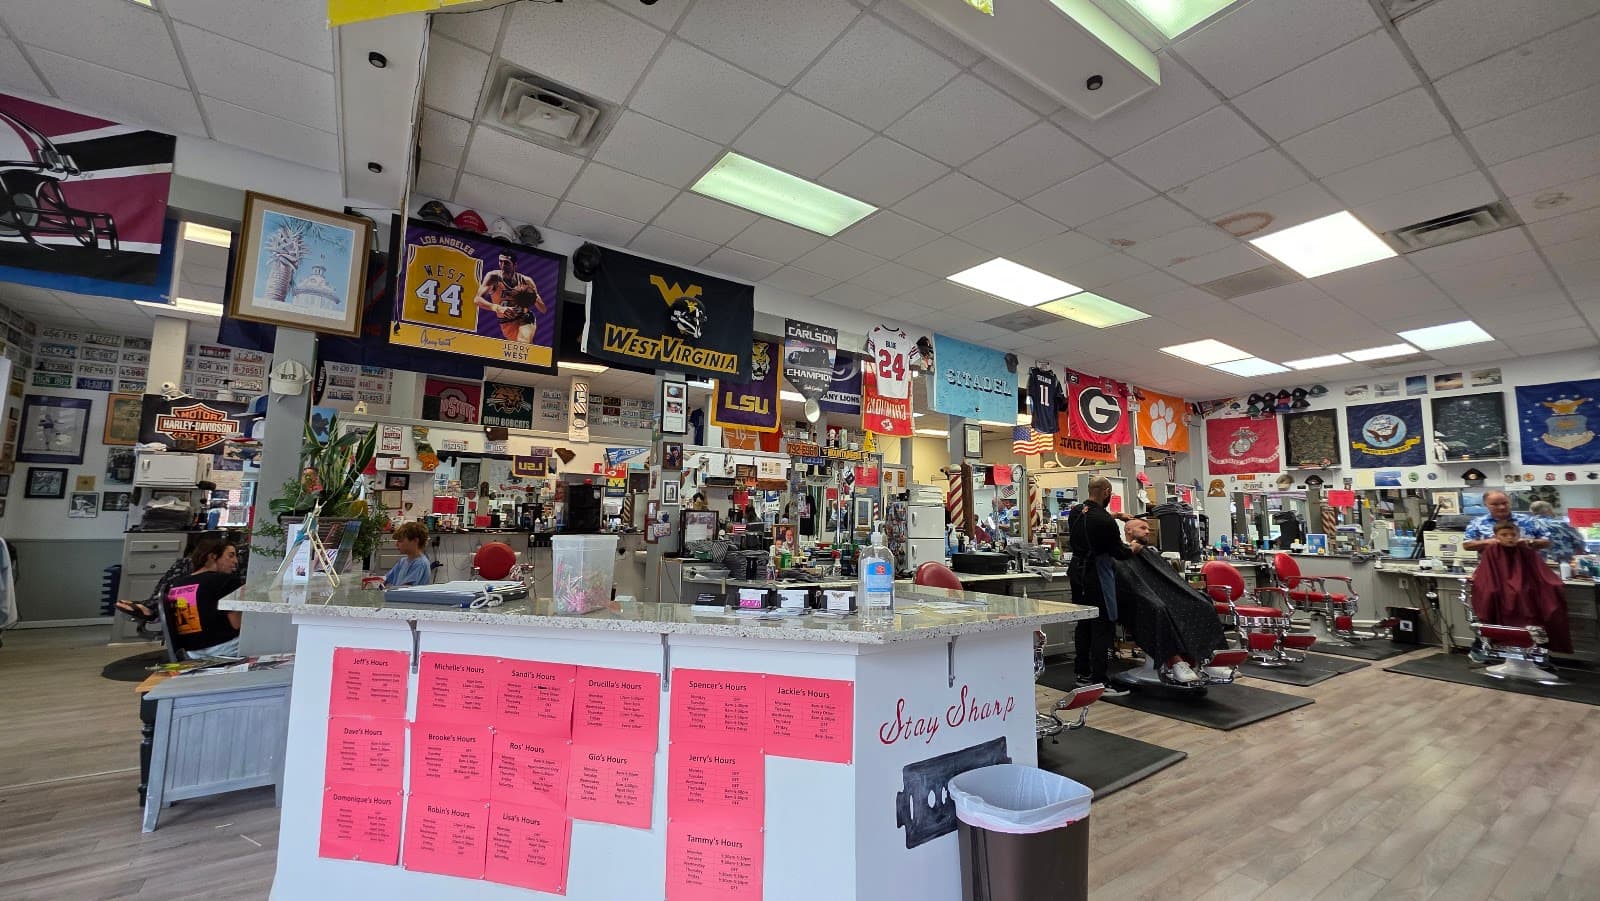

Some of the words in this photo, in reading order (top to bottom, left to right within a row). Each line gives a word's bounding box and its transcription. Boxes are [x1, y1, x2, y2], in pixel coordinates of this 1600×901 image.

[420, 235, 437, 245] LOS
[439, 237, 476, 256] ANGELES
[424, 265, 466, 282] WEST
[415, 279, 464, 318] 44
[788, 326, 836, 345] CARLSON
[503, 343, 530, 353] JERRY
[603, 322, 660, 359] WEST
[660, 335, 738, 373] VIRGINIA
[885, 340, 897, 349] BLUE
[503, 351, 528, 361] WEST
[878, 348, 905, 381] 24
[1039, 384, 1050, 406] 11
[725, 391, 769, 415] LSU
[181, 410, 218, 420] MOTOR
[1078, 386, 1122, 434] G
[163, 419, 232, 433] HARLEY-DAVIDSON
[484, 416, 499, 425] OHIO
[501, 418, 529, 428] BOBCATS
[435, 663, 464, 672] Michelle's
[511, 670, 534, 679] Sandi's
[588, 680, 619, 688] Drucilla's
[621, 682, 642, 690] Hours
[689, 681, 723, 690] Spencer's
[725, 683, 747, 691] Hours
[778, 687, 805, 696] Jackie's
[807, 690, 830, 698] Hours
[880, 698, 939, 744] Stay
[946, 685, 1016, 727] Sharp
[428, 733, 455, 741] Brooke's
[510, 742, 523, 750] Ros'
[525, 744, 544, 753] Hours
[588, 753, 605, 762] Gio's
[607, 755, 627, 764] Hours
[689, 754, 713, 763] Jerry's
[714, 756, 736, 764] Hours
[374, 797, 392, 805] Hours
[428, 806, 449, 815] Robin's
[451, 808, 470, 817] Hours
[502, 812, 519, 820] Lisa's
[521, 816, 541, 825] Hours
[687, 835, 719, 846] Tammy's
[721, 839, 743, 848] Hours
